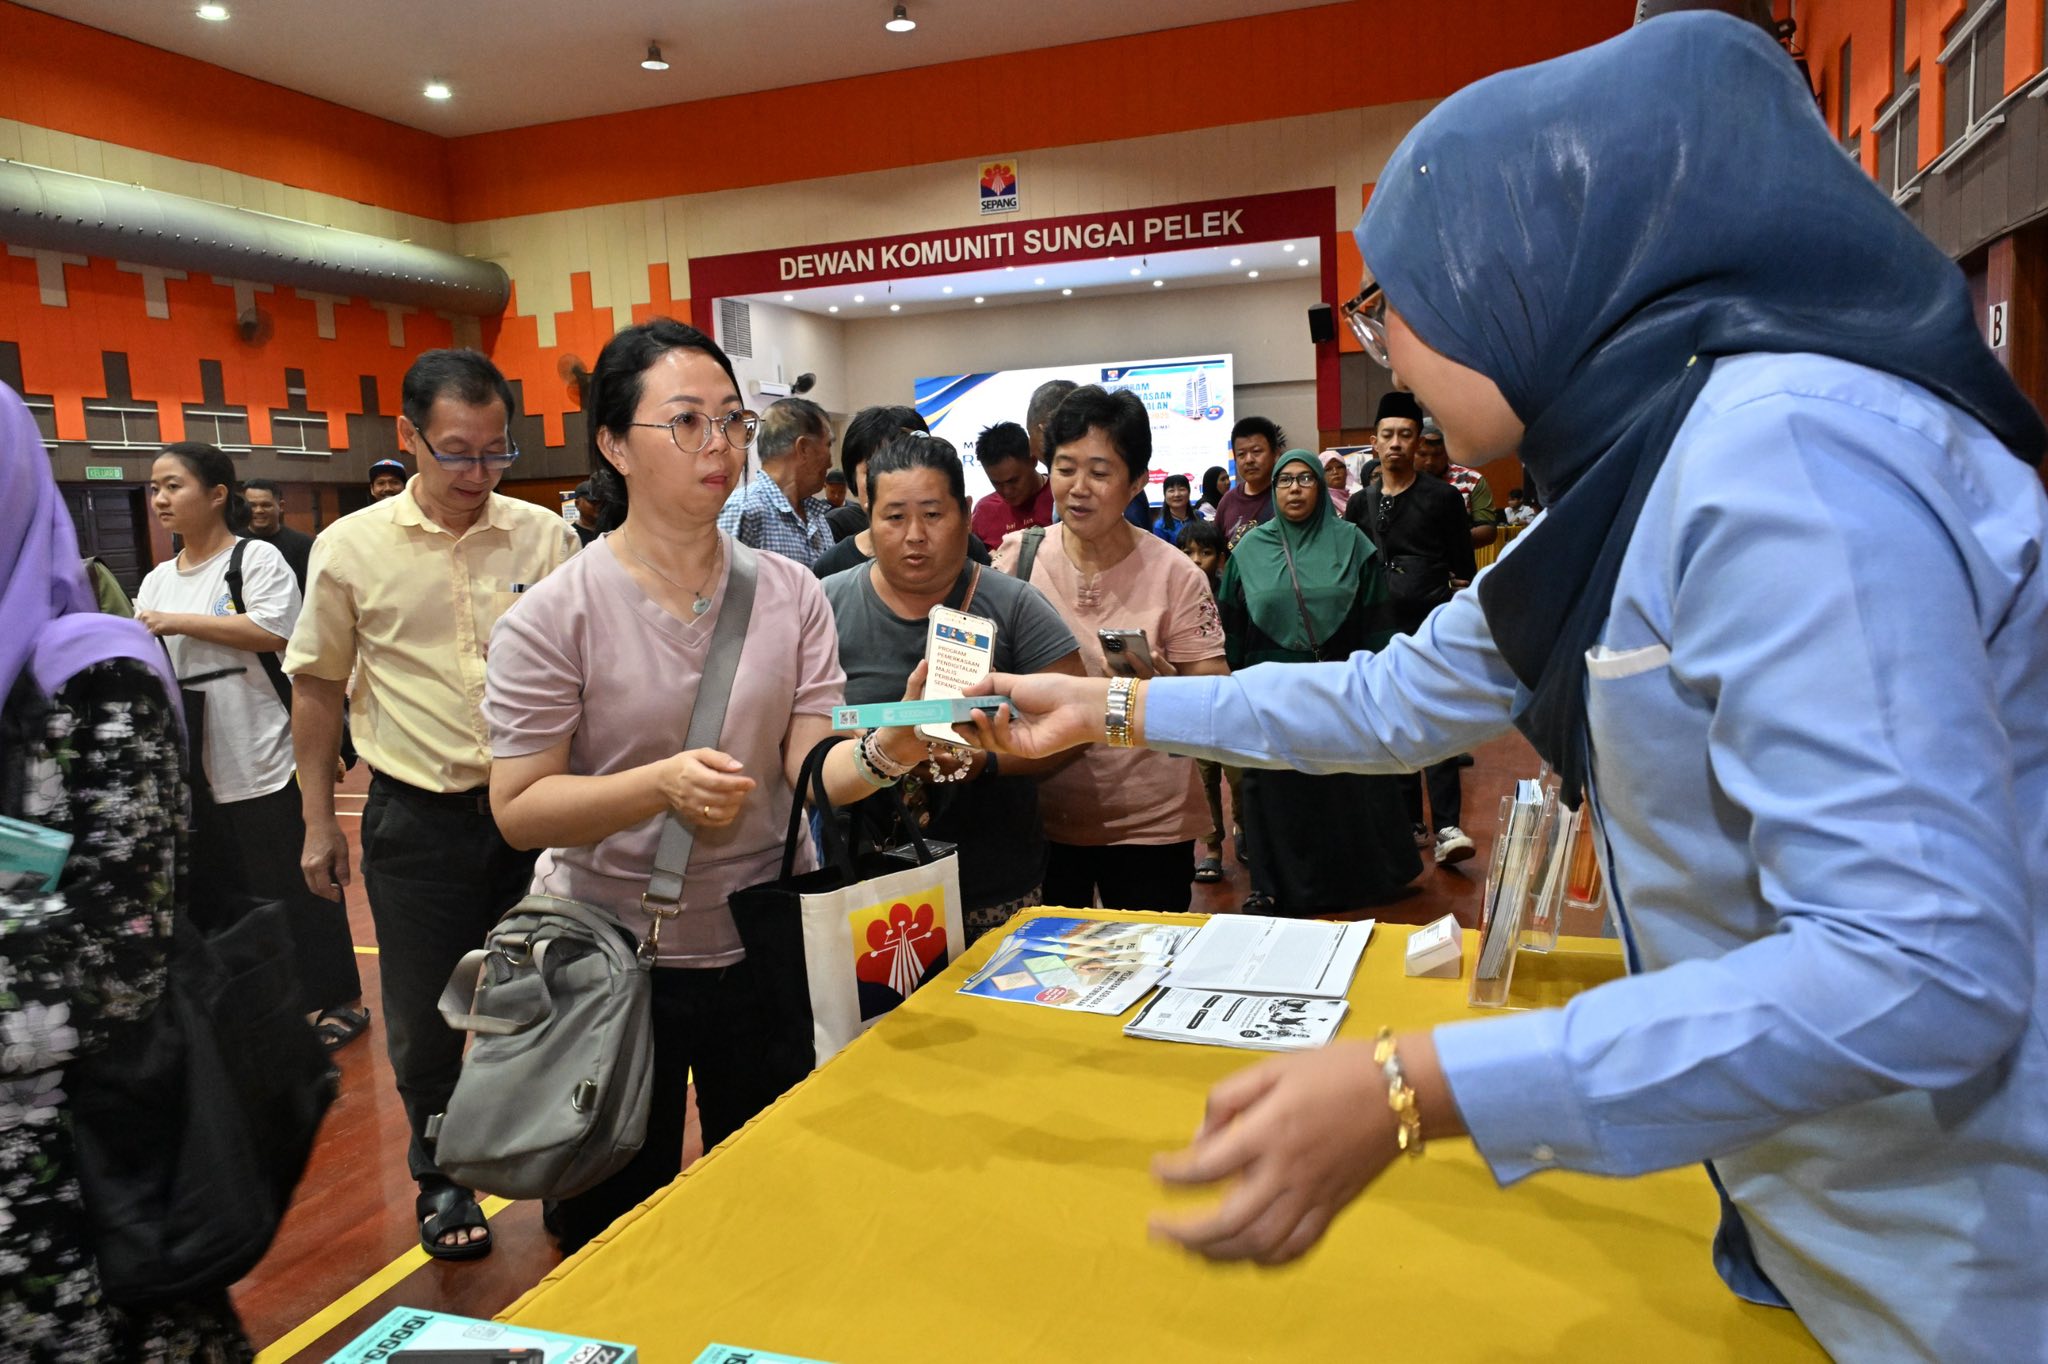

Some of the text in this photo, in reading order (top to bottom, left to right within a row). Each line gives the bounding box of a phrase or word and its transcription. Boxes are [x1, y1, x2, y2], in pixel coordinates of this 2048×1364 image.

[981, 197, 1017, 210] SEPANG
[779, 209, 1244, 281] DEWAN KOMUNITI SUNGAI PELEK
[1993, 305, 2002, 347] B
[937, 645, 967, 657] PROGRAM
[936, 658, 978, 674] PENDIGITALAN
[937, 652, 980, 668] PEMERKASAAN
[935, 665, 957, 676] MAJLIS
[934, 679, 957, 689] SEPANG
